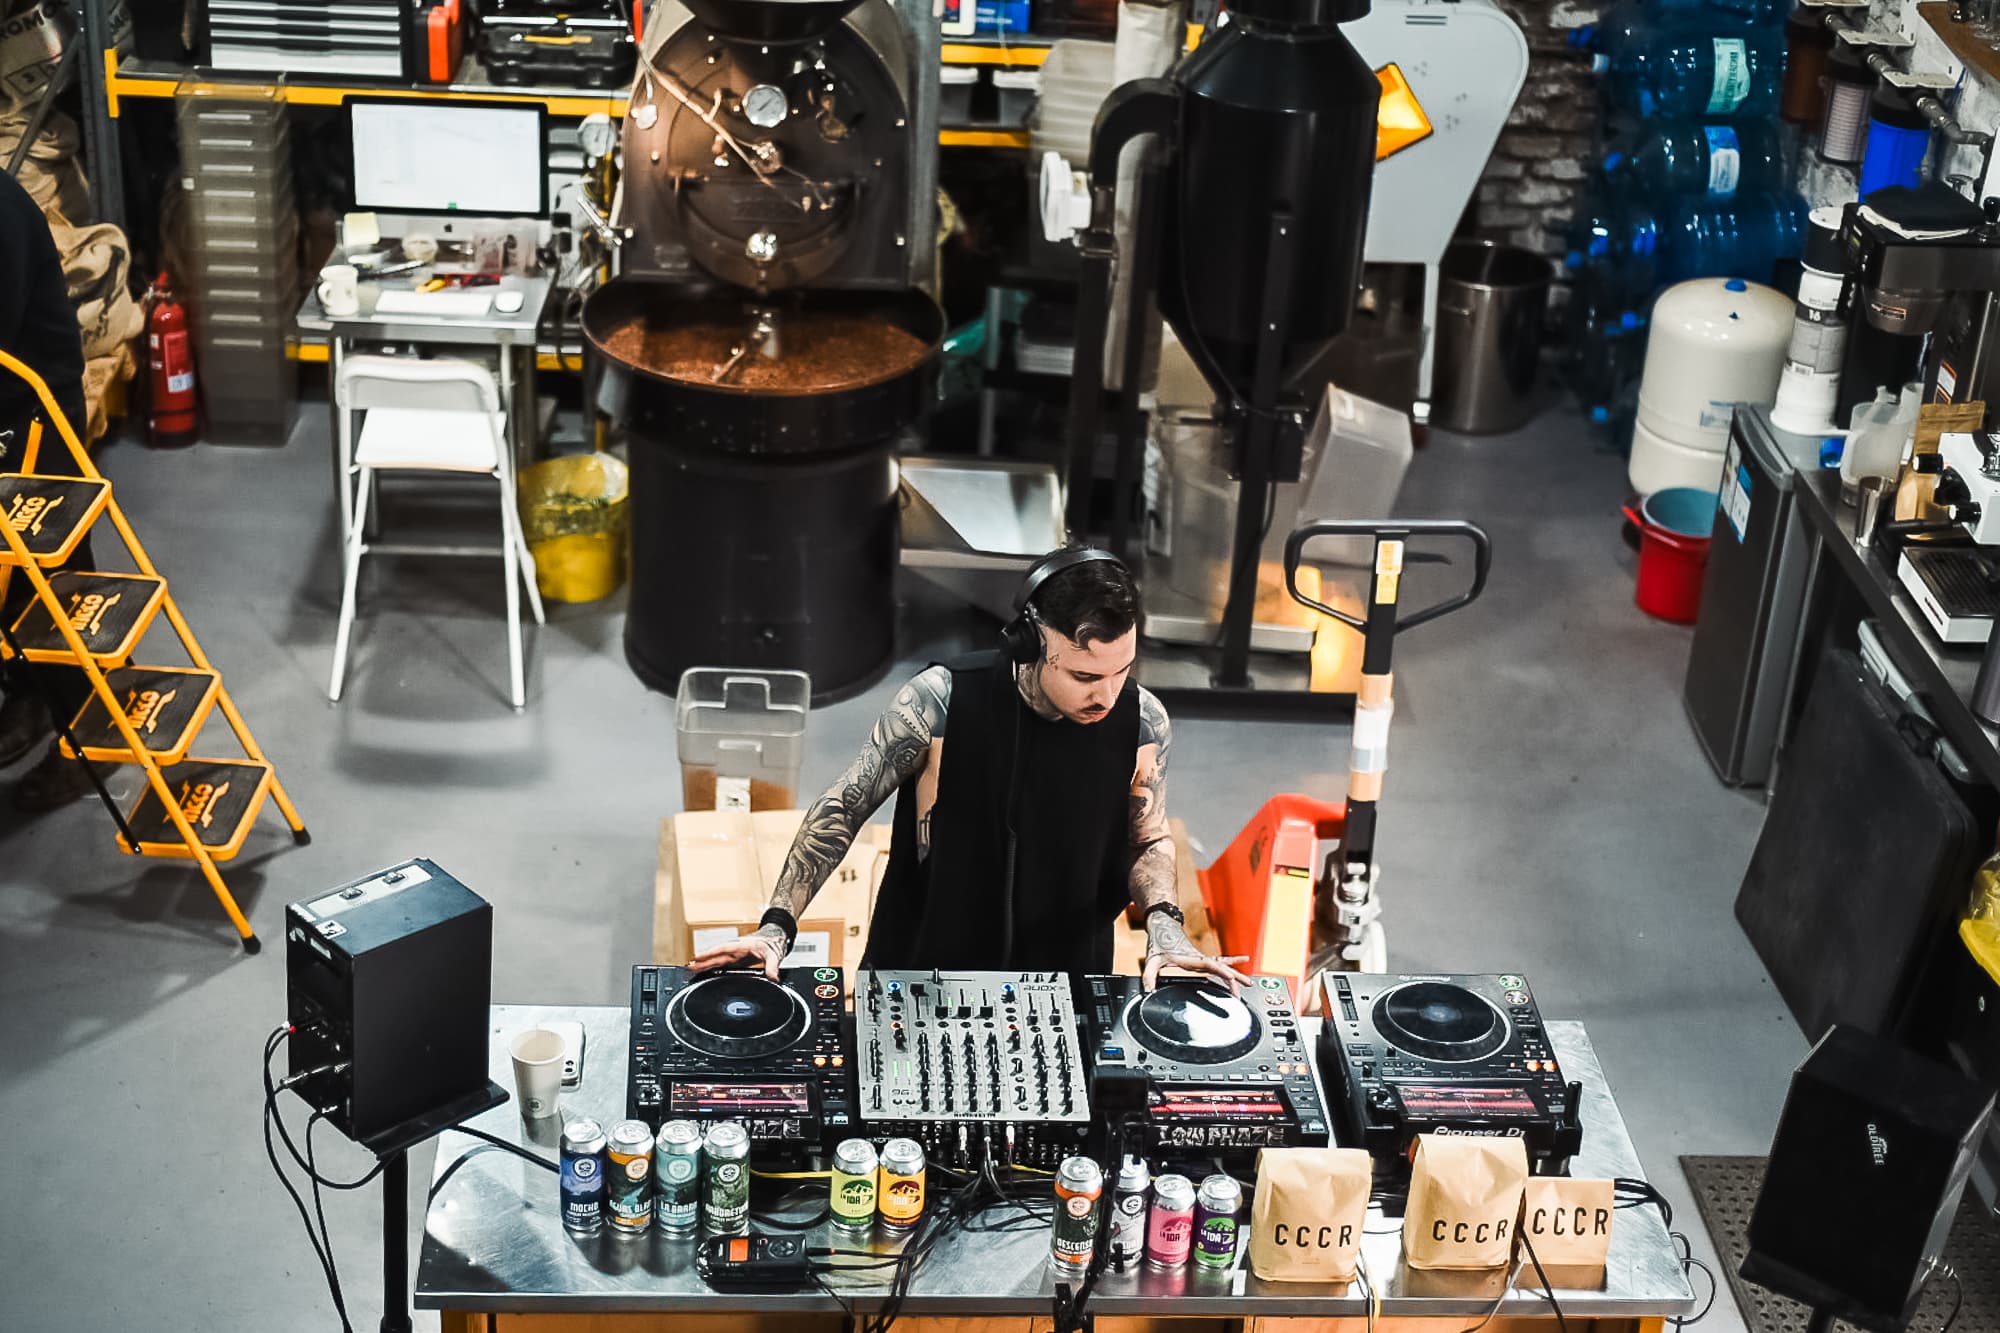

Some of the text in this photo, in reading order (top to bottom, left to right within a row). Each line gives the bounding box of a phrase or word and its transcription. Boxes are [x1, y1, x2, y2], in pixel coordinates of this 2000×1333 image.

[1433, 1125, 1503, 1136] Pioneer
[1432, 1219, 1509, 1243] CCCR
[1532, 1206, 1609, 1235] CCCR
[1207, 1232, 1221, 1242] IDA
[1275, 1223, 1352, 1248] CCCR
